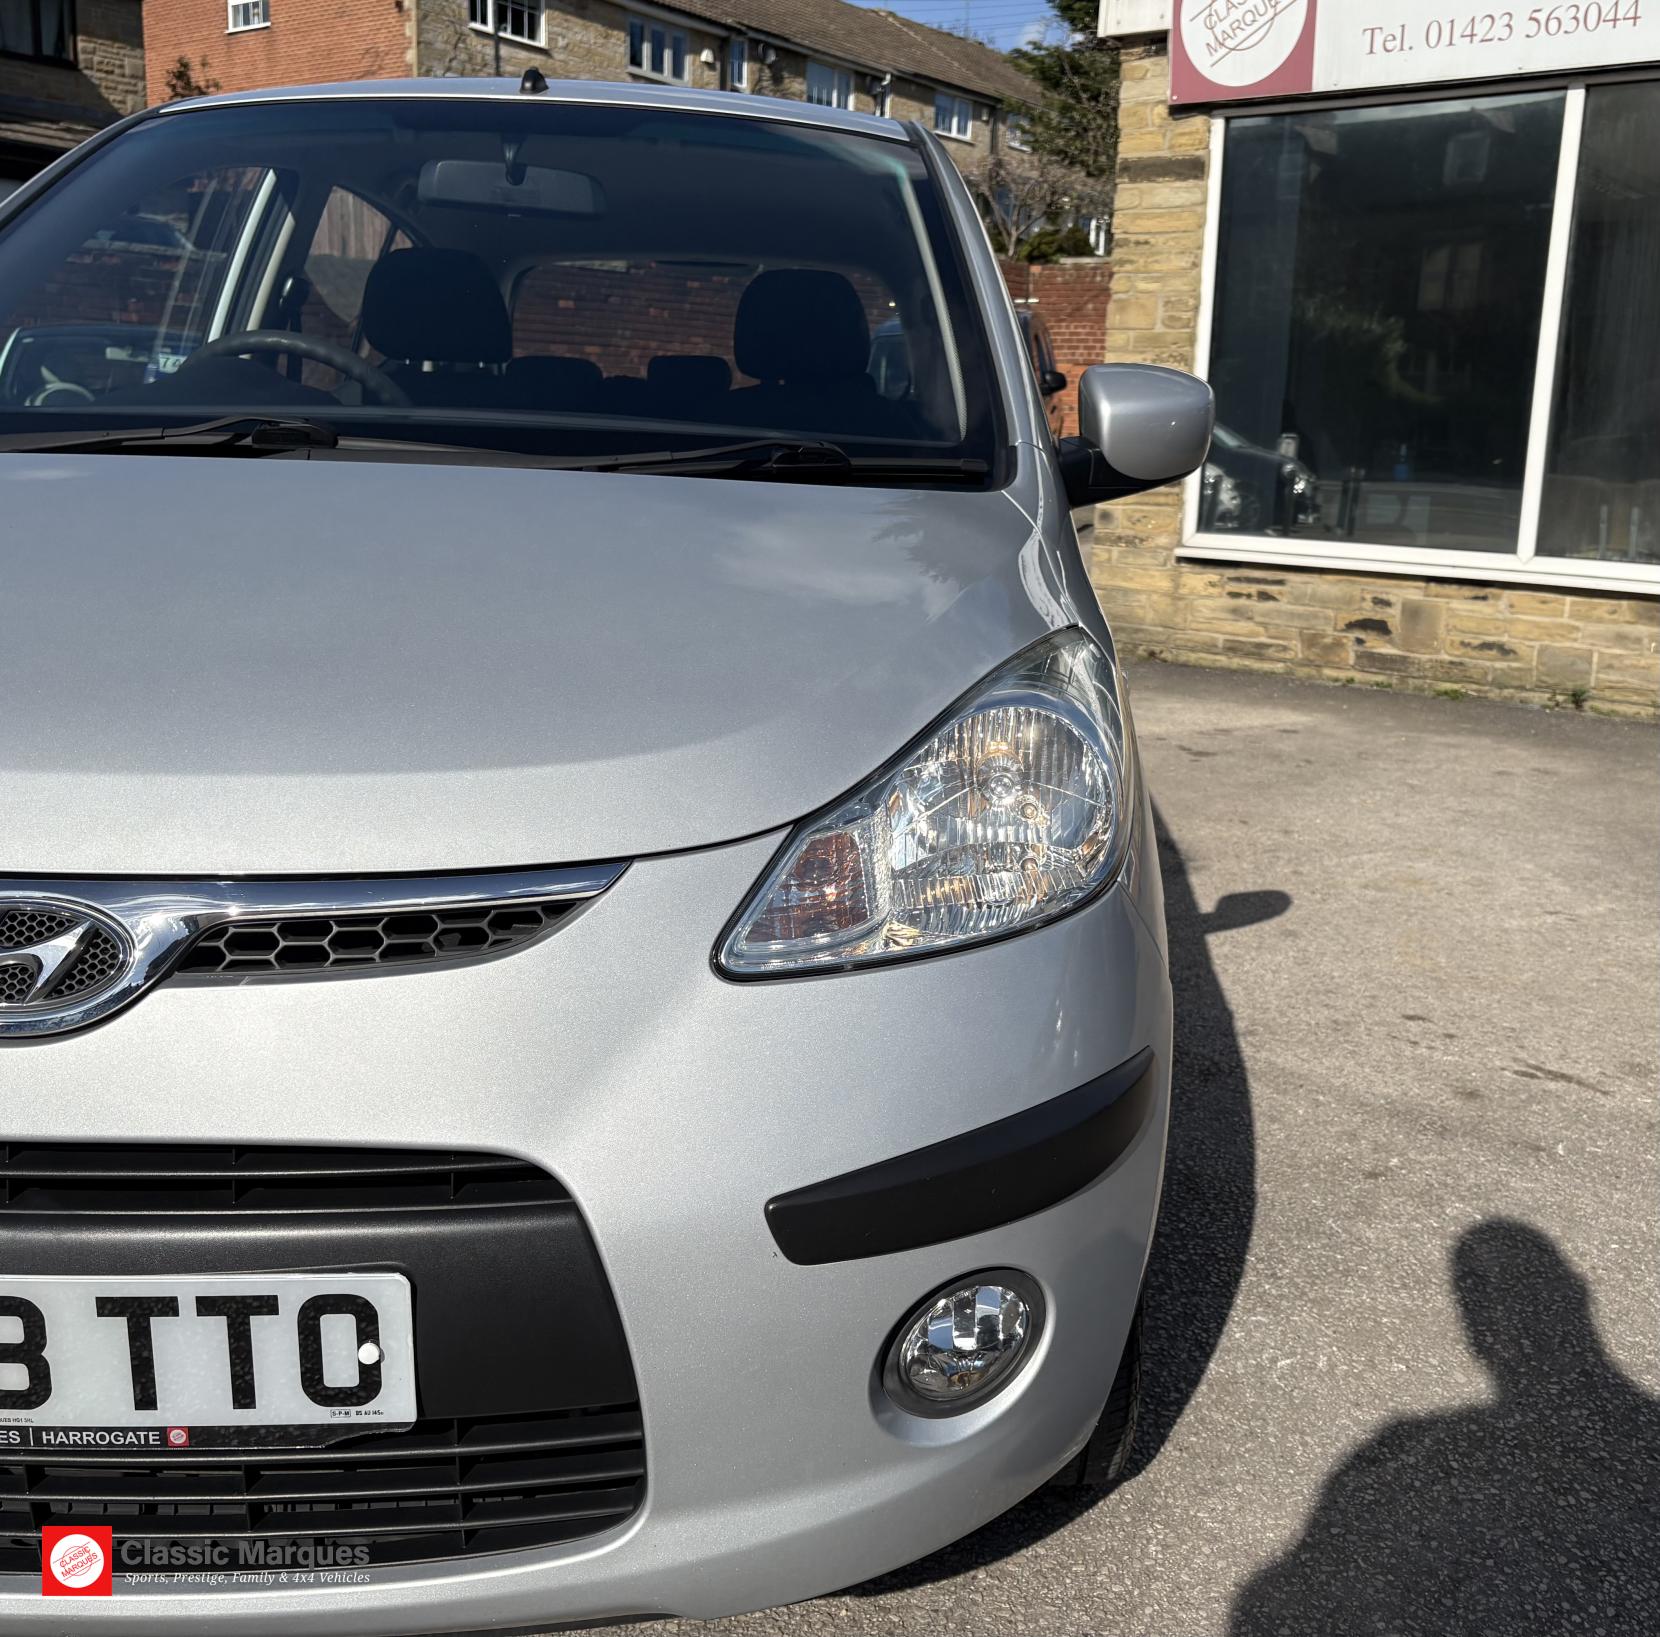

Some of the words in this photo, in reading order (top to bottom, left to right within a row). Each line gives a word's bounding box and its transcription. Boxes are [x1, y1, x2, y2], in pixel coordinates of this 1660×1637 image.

[1362, 24, 1414, 55] Tel.
[1425, 12, 1514, 49] 01423
[1525, 0, 1642, 38] 563044
[95, 1294, 383, 1411] TTO
[42, 1431, 161, 1445] HARROGATE
